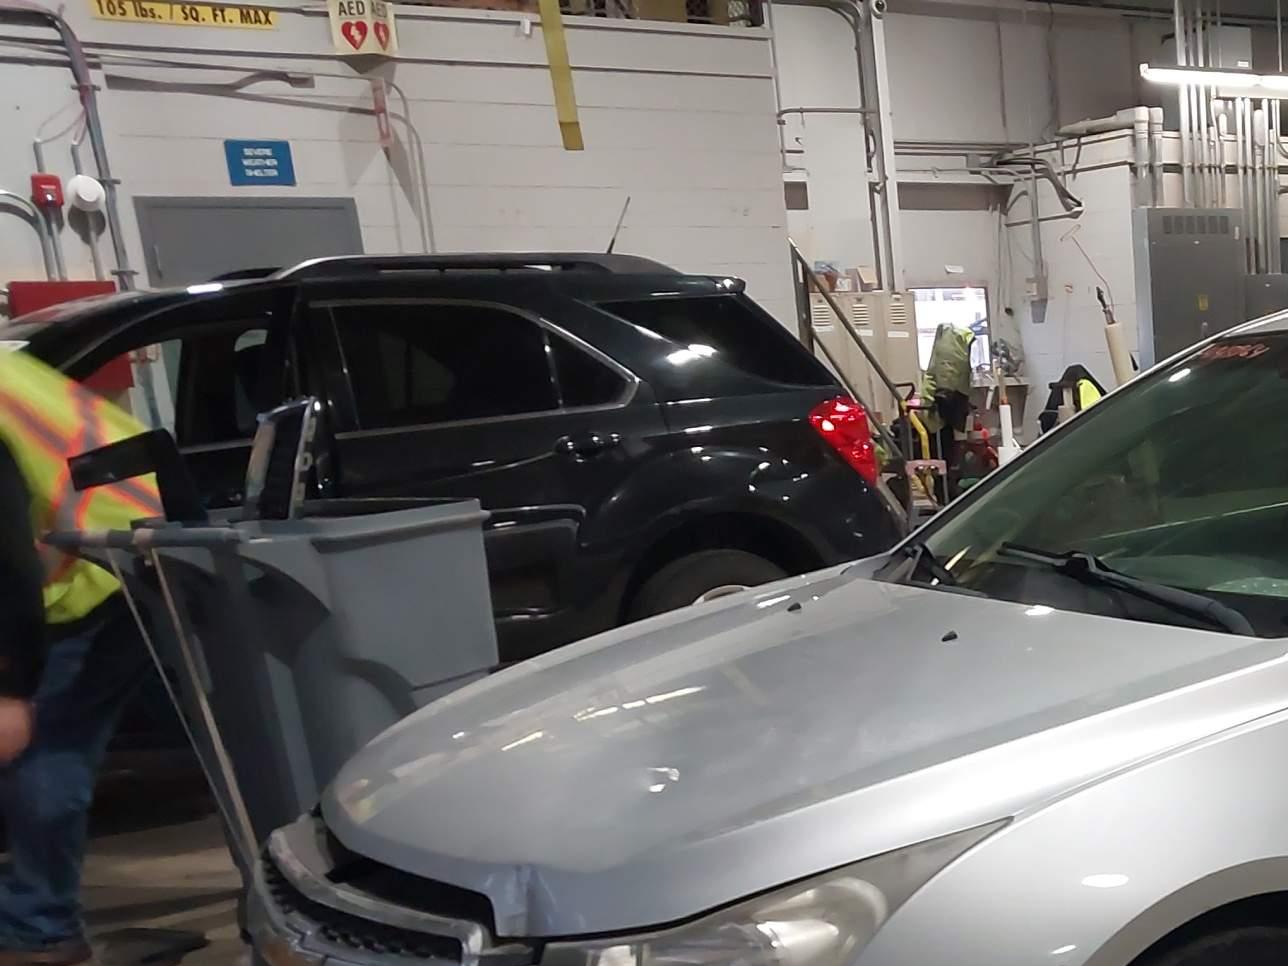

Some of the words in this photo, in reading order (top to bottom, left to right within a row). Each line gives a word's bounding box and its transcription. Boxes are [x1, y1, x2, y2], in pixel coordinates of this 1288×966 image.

[97, 0, 127, 17] 105
[134, 2, 162, 19] lbs.
[181, 5, 206, 23] SQ.
[212, 7, 233, 24] FT.
[239, 8, 273, 26] MAX
[338, 0, 366, 16] AED
